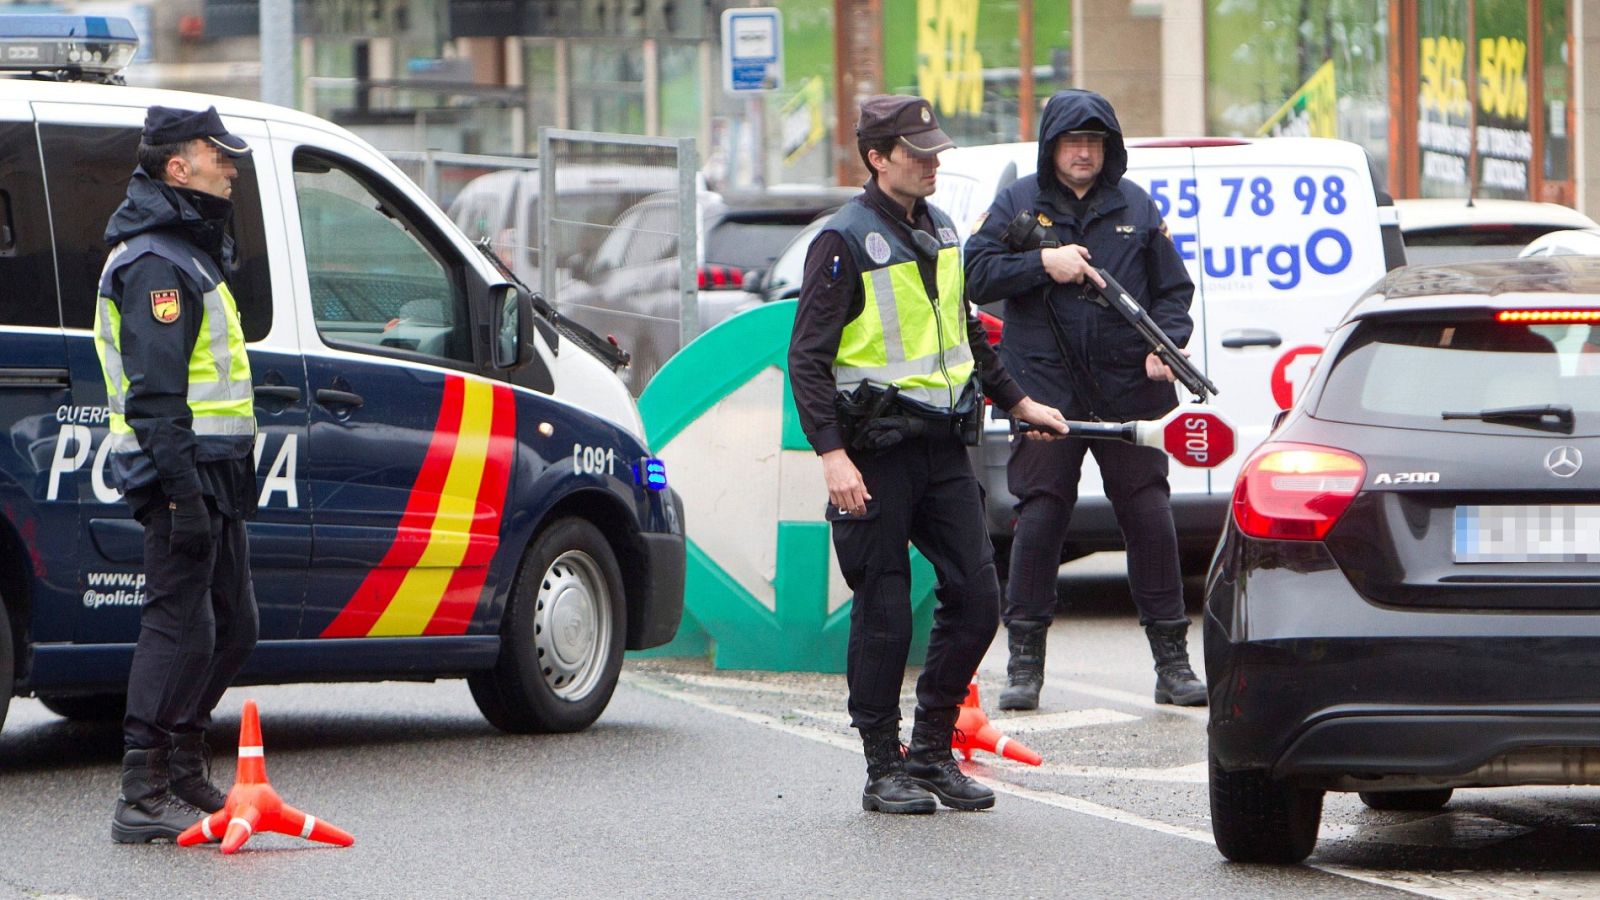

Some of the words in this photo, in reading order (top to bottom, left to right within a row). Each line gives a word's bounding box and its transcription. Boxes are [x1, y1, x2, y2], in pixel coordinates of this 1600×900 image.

[1479, 36, 1528, 121] 50%
[1150, 179, 1199, 218] 55
[1220, 176, 1273, 216] 78
[1293, 175, 1346, 215] 98
[1185, 418, 1208, 462] STOP
